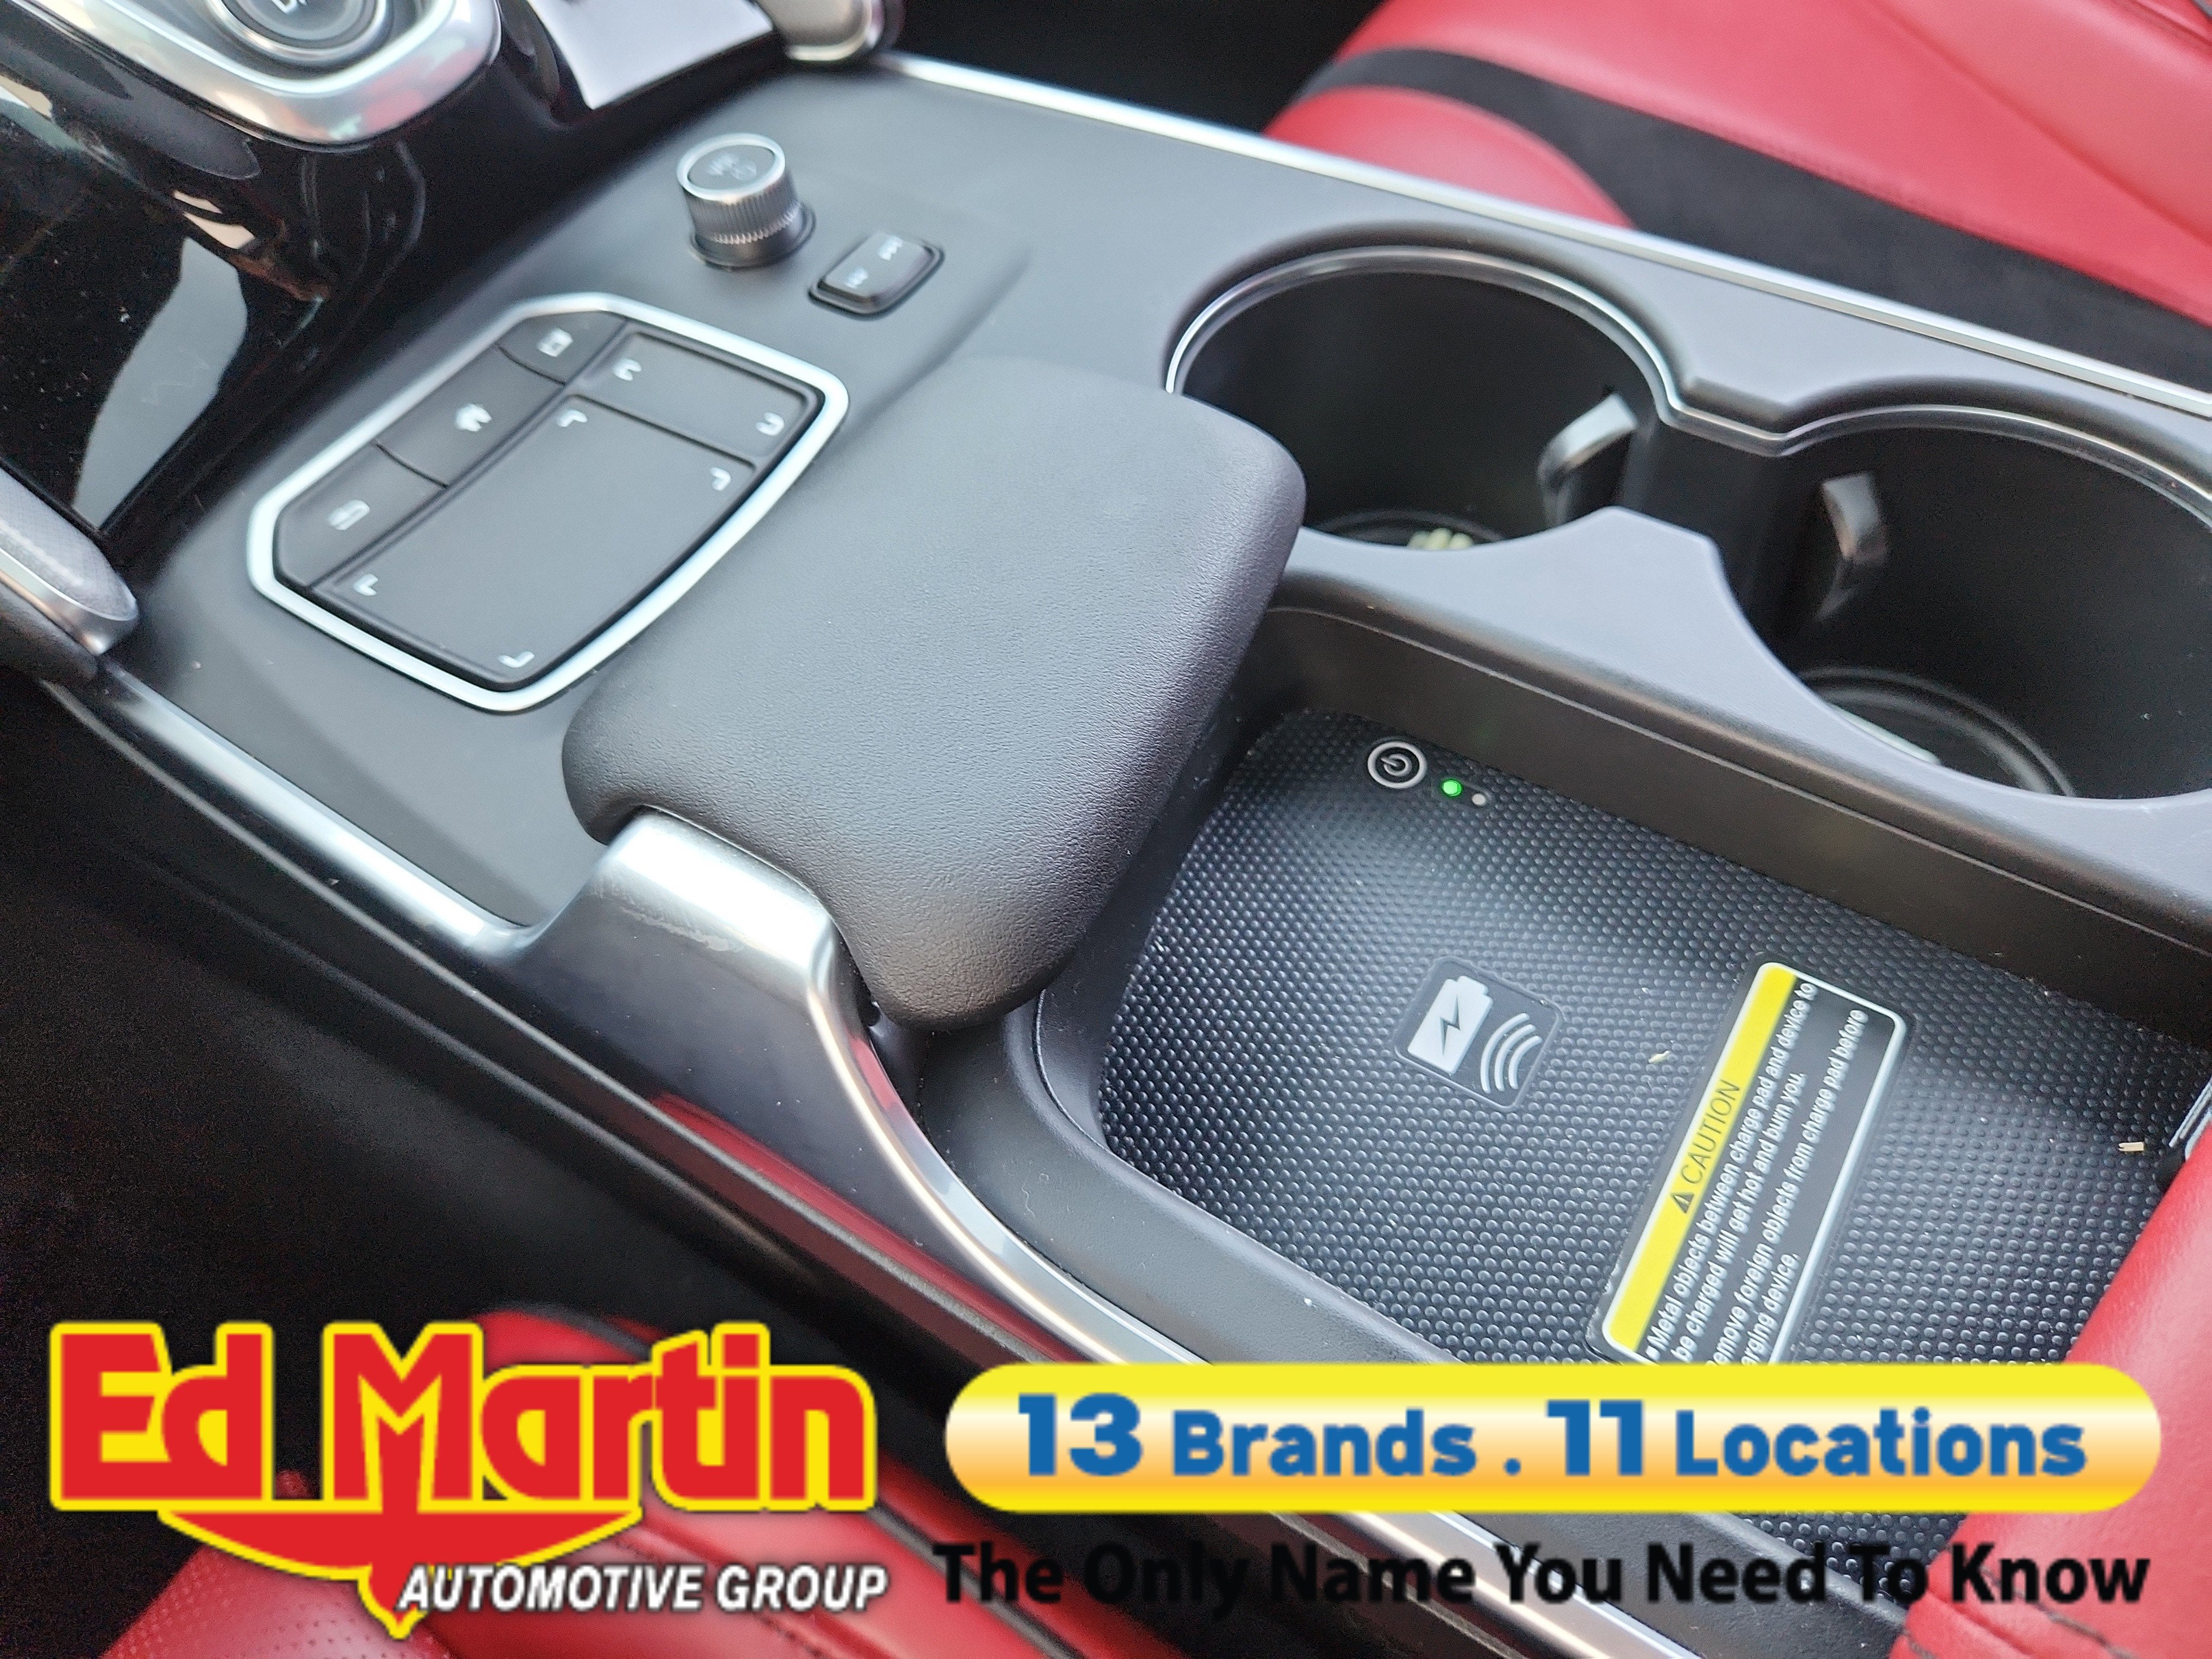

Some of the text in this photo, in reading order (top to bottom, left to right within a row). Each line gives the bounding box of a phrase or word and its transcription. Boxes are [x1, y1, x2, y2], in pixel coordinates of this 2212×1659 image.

[1681, 1079, 1740, 1184] CAUTION
[1761, 1103, 1795, 1142] burn
[1646, 982, 1819, 1352] Metal objects between charge pad and device to
[1752, 1138, 1779, 1174] and
[1704, 1009, 1870, 1366] emove foreign objects from charge pad before
[1736, 1171, 1765, 1205] hot
[1728, 1201, 1754, 1234] get
[1714, 1229, 1741, 1265] will
[1686, 1260, 1728, 1338] charged
[1670, 1336, 1698, 1362] be
